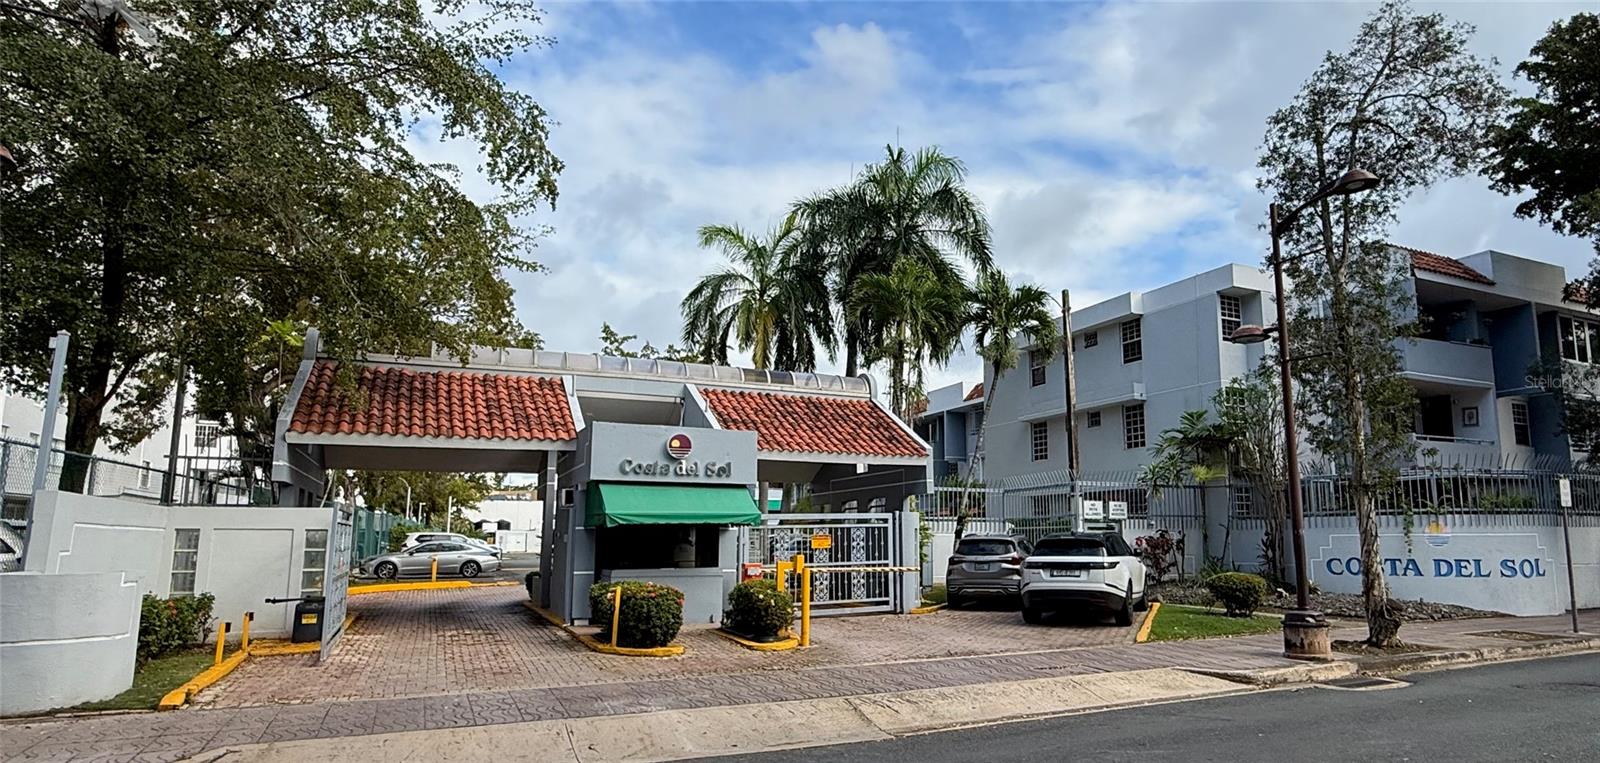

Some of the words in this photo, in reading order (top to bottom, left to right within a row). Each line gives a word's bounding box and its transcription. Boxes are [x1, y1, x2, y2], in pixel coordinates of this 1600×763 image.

[619, 457, 670, 476] Costa
[675, 460, 699, 478] del
[705, 461, 732, 478] Sol
[1326, 556, 1424, 577] COTA
[1433, 558, 1491, 578] DEL
[1500, 558, 1546, 578] SOL
